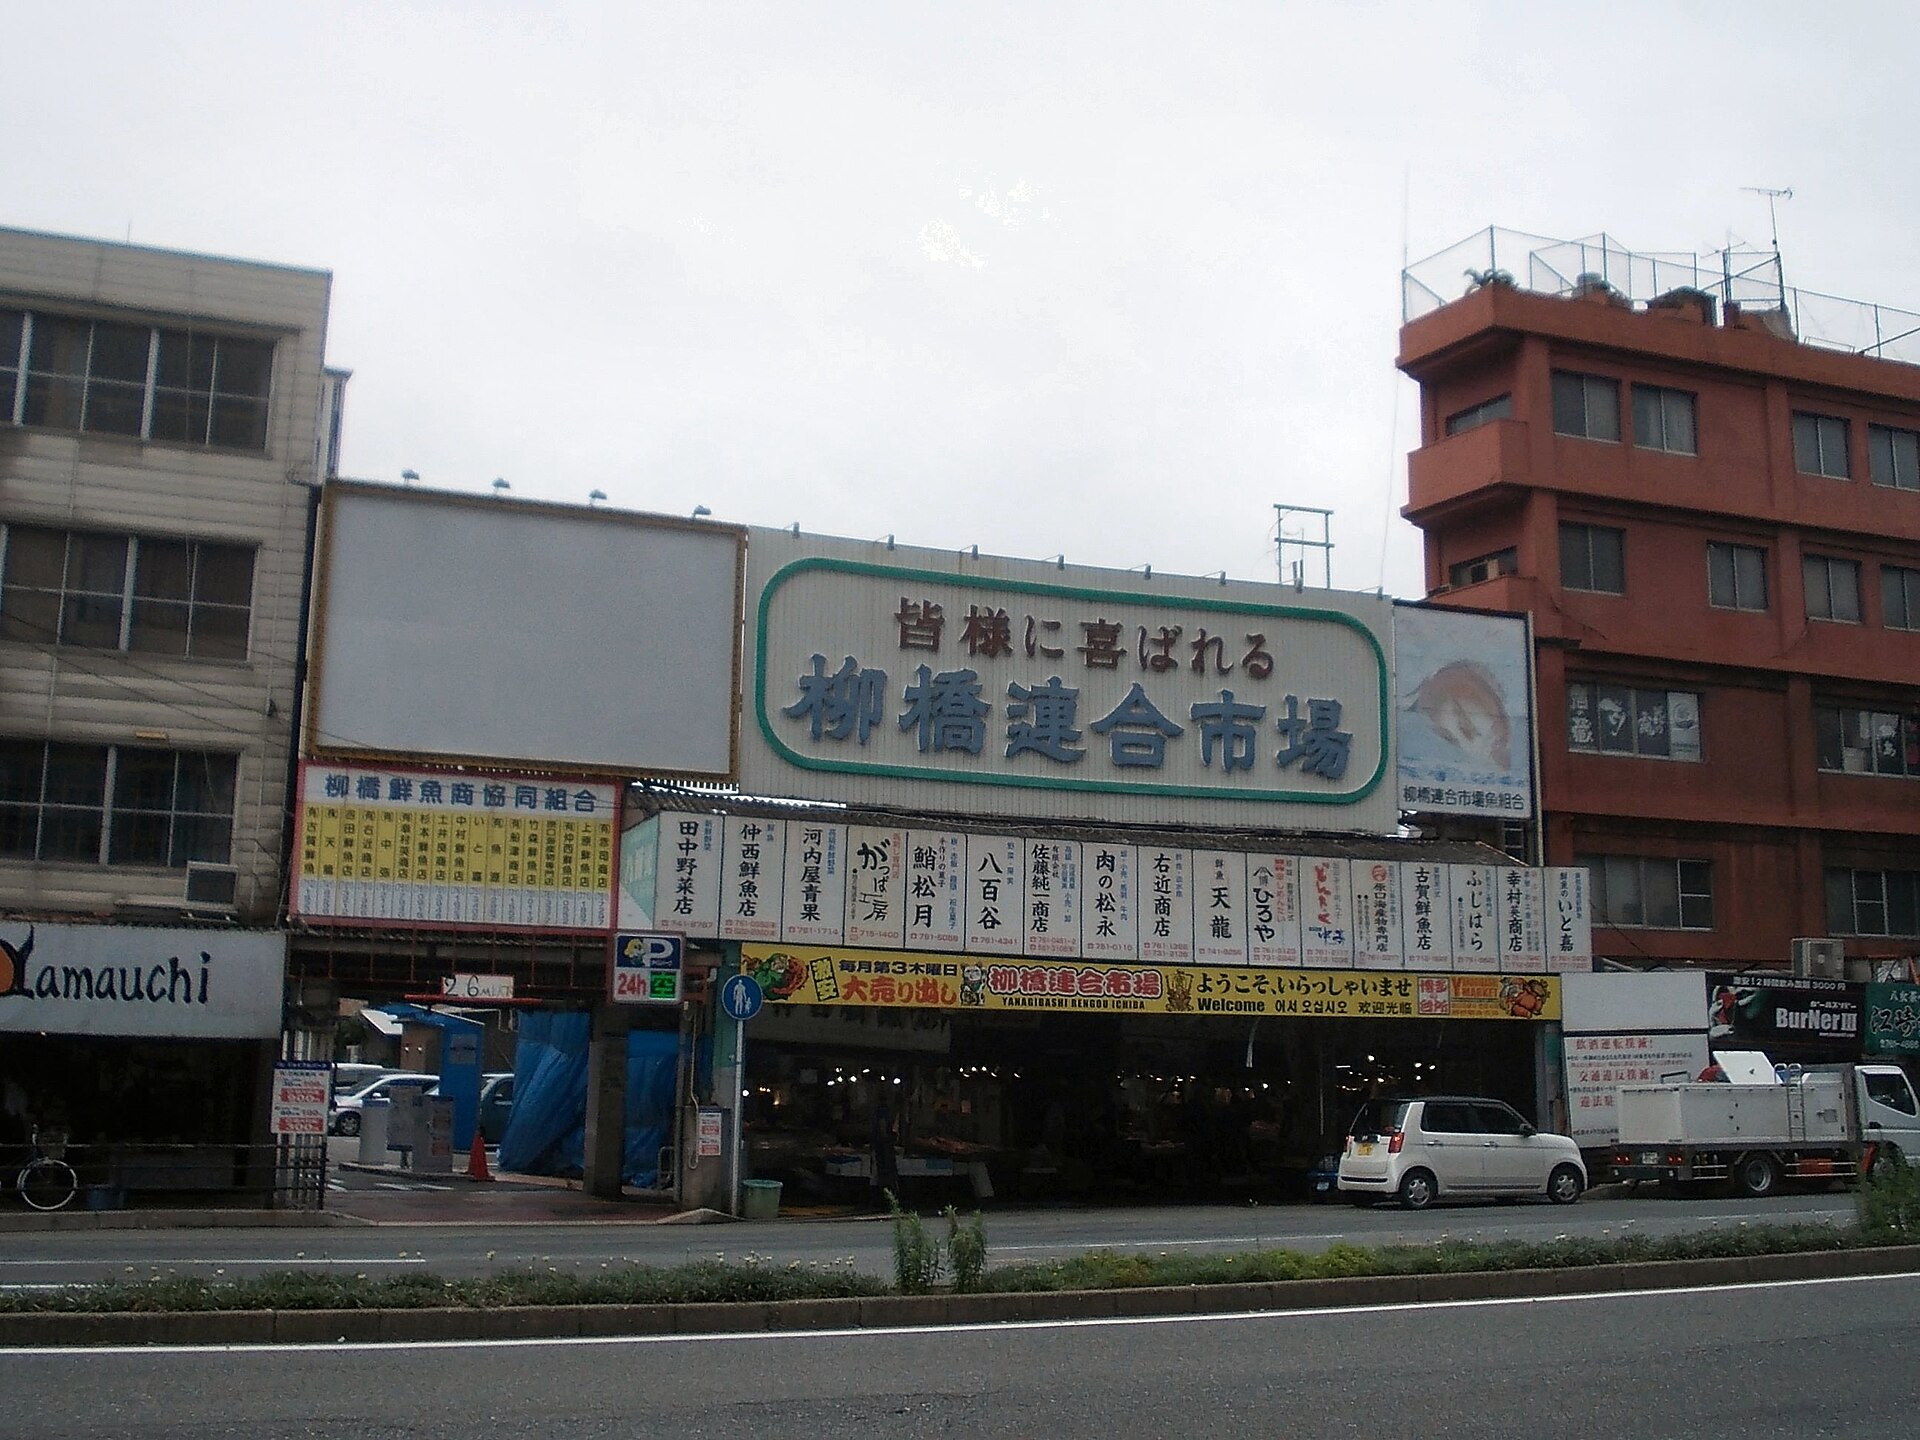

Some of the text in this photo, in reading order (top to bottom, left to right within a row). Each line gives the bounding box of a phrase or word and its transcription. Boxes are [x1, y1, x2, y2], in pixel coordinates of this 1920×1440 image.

[895, 597, 1275, 679] 皆様に喜ばれる
[782, 653, 1354, 780] 柳橋連合市場
[324, 773, 598, 813] 柳橋鮮魚商協同組合
[673, 820, 700, 915] 田中野菜店
[737, 823, 762, 917] 仲西鮮魚店
[800, 828, 823, 922] 河内屋青果
[977, 851, 1003, 930] 八百谷
[1031, 843, 1051, 933] 佐藤純一商店
[1095, 849, 1117, 938] 肉の松永
[1152, 853, 1172, 938] 右近商店
[1414, 866, 1433, 951] 古賀鮮魚店
[1209, 886, 1233, 940] 天龍
[1252, 887, 1276, 943] ひろや
[1466, 869, 1484, 951] ふじはら
[1507, 869, 1524, 952] 幸村英商店
[617, 973, 647, 996] 24h
[838, 959, 958, 977] 毎月第3木曜日
[988, 964, 1163, 999] 柳橋連合市場
[1196, 972, 1413, 997] ようこそ、いらっしゃいませ
[1197, 997, 1266, 1012] Welcome
[1275, 999, 1348, 1014] 어서 오십시오
